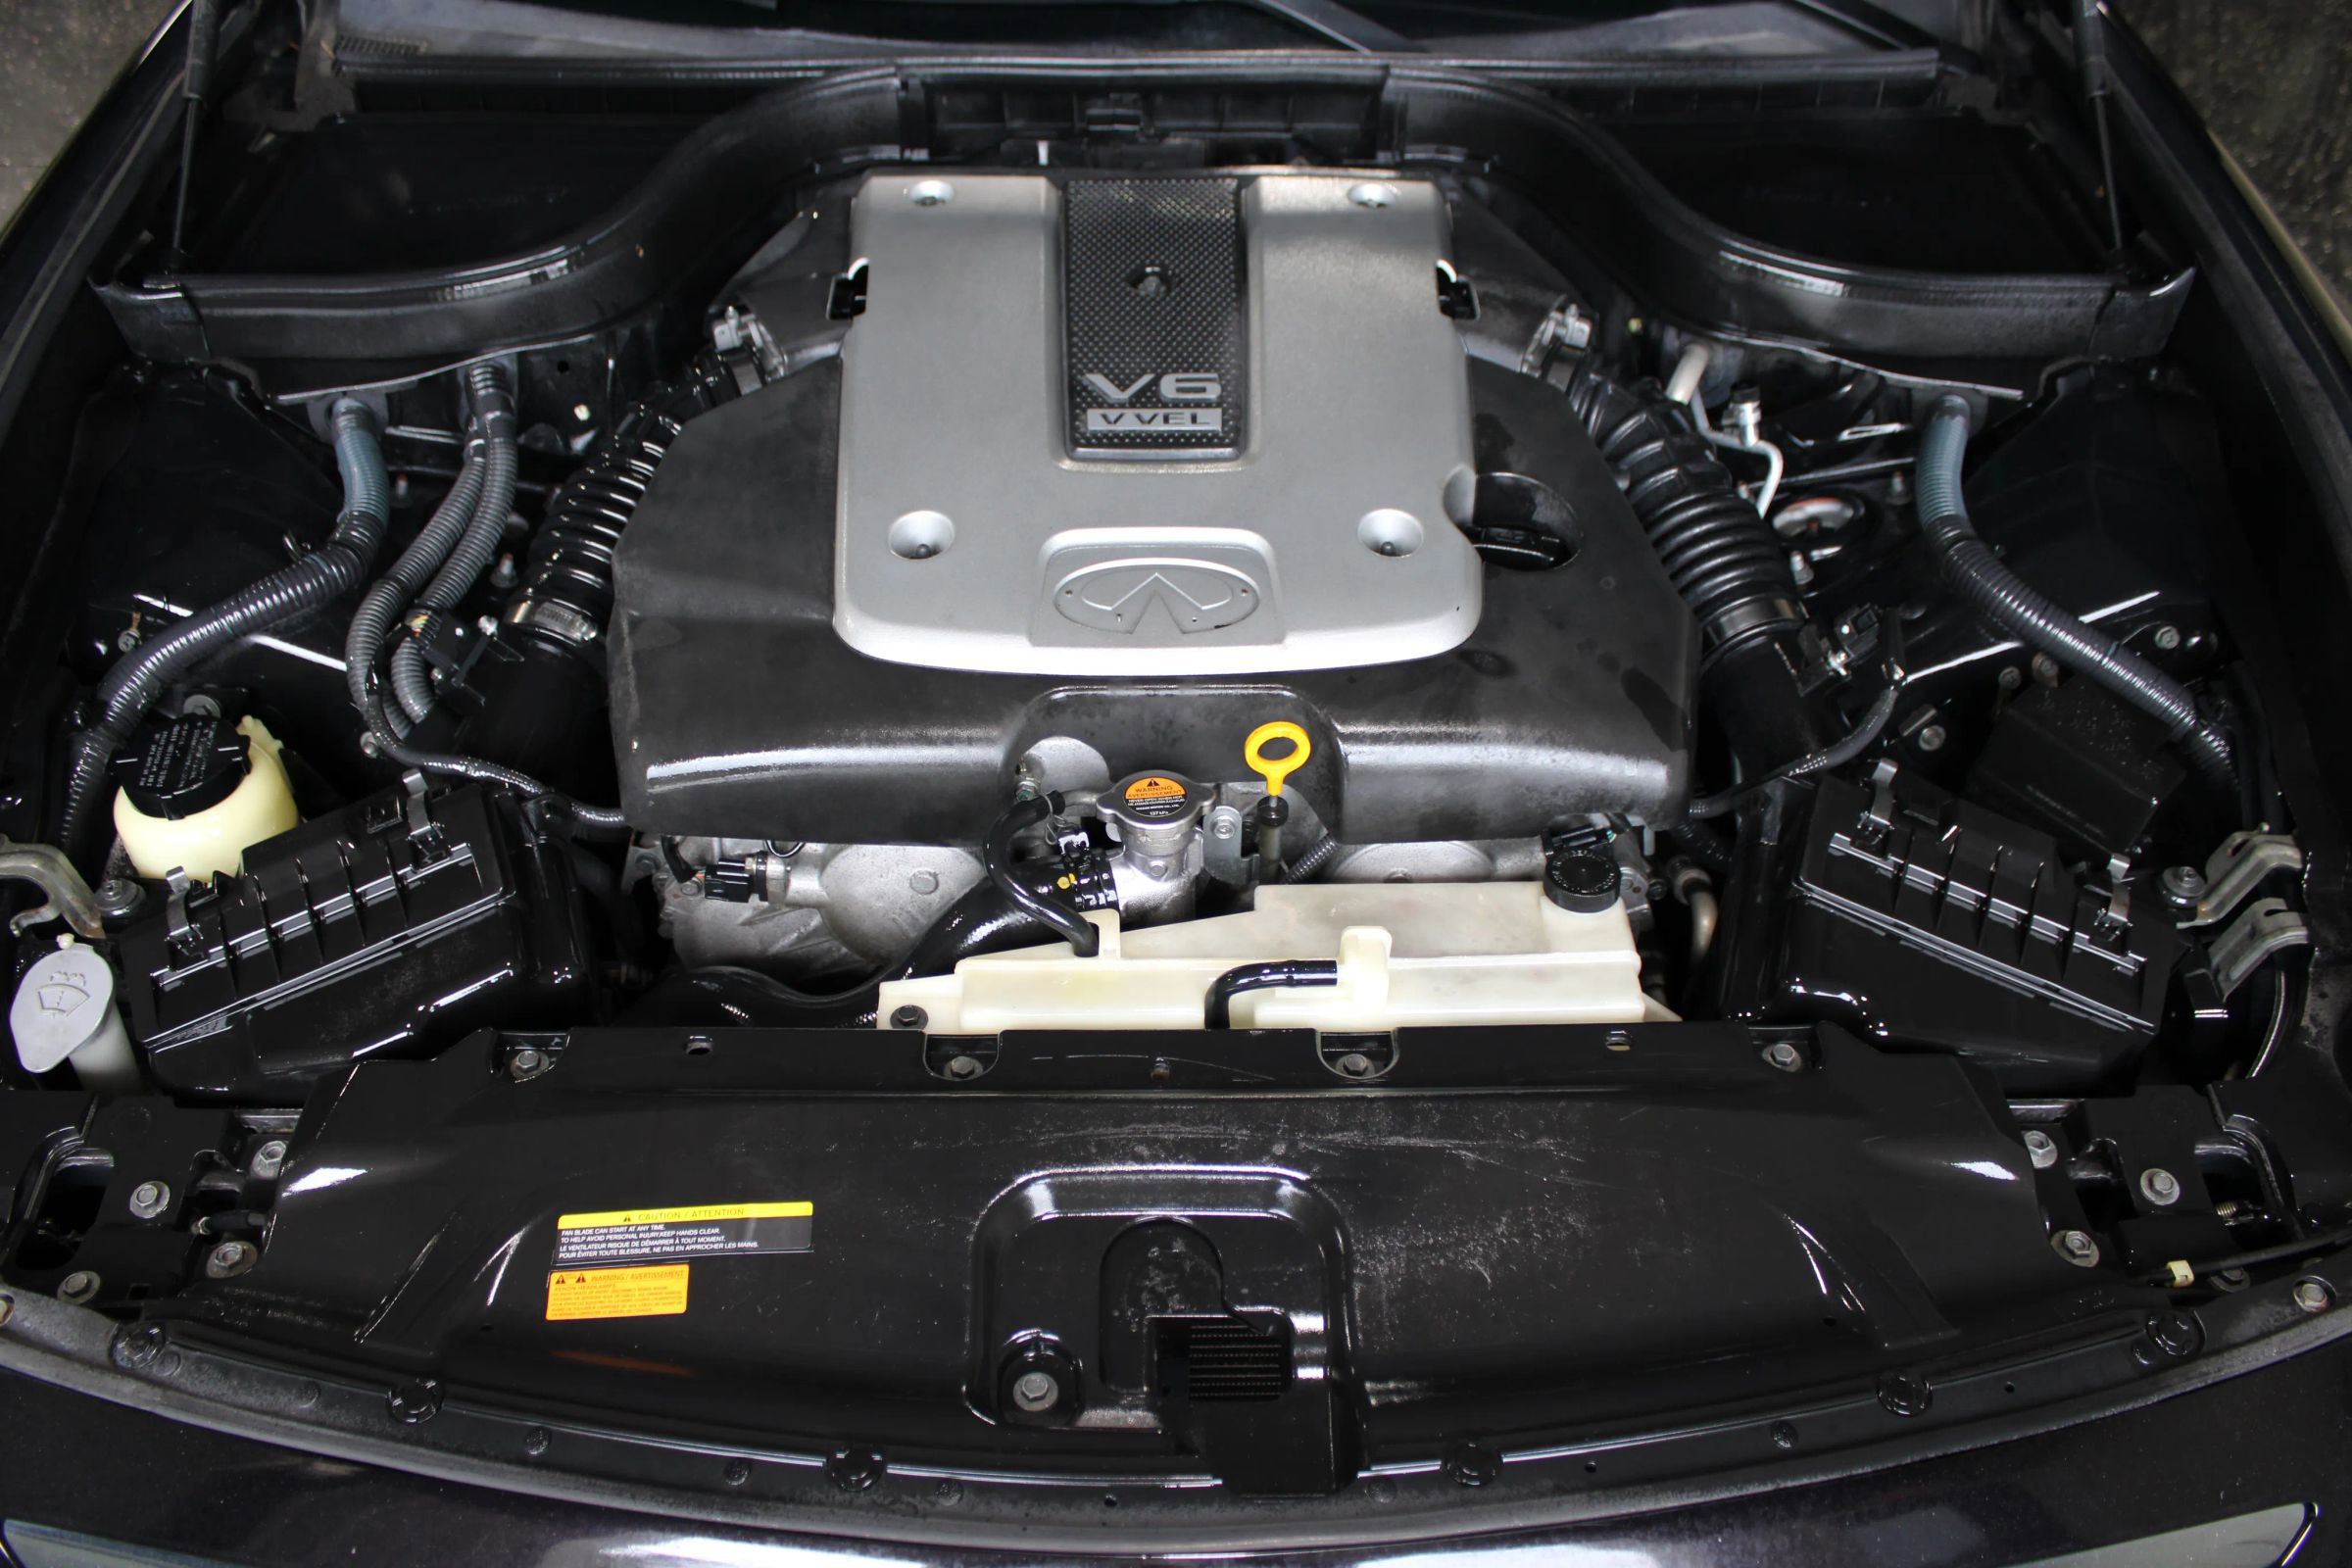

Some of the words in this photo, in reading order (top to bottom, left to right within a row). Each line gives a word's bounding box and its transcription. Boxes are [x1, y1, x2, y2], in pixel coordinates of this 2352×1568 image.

[1082, 372, 1222, 404] V6
[637, 1211, 681, 1222] CAUTION
[691, 1208, 745, 1218] ATTENTION
[567, 1243, 607, 1251] VENTILATEUR
[608, 1241, 630, 1250] RISQUE
[640, 1238, 674, 1247] DÉMARRER
[697, 1235, 726, 1244] MOMENT.
[586, 1234, 606, 1243] AVOID
[606, 1232, 638, 1241] PERSONAL
[577, 1250, 598, 1258] ÉVITER
[685, 1243, 724, 1251] APPROCHER
[630, 1270, 685, 1280] AVERTISSEMENT
